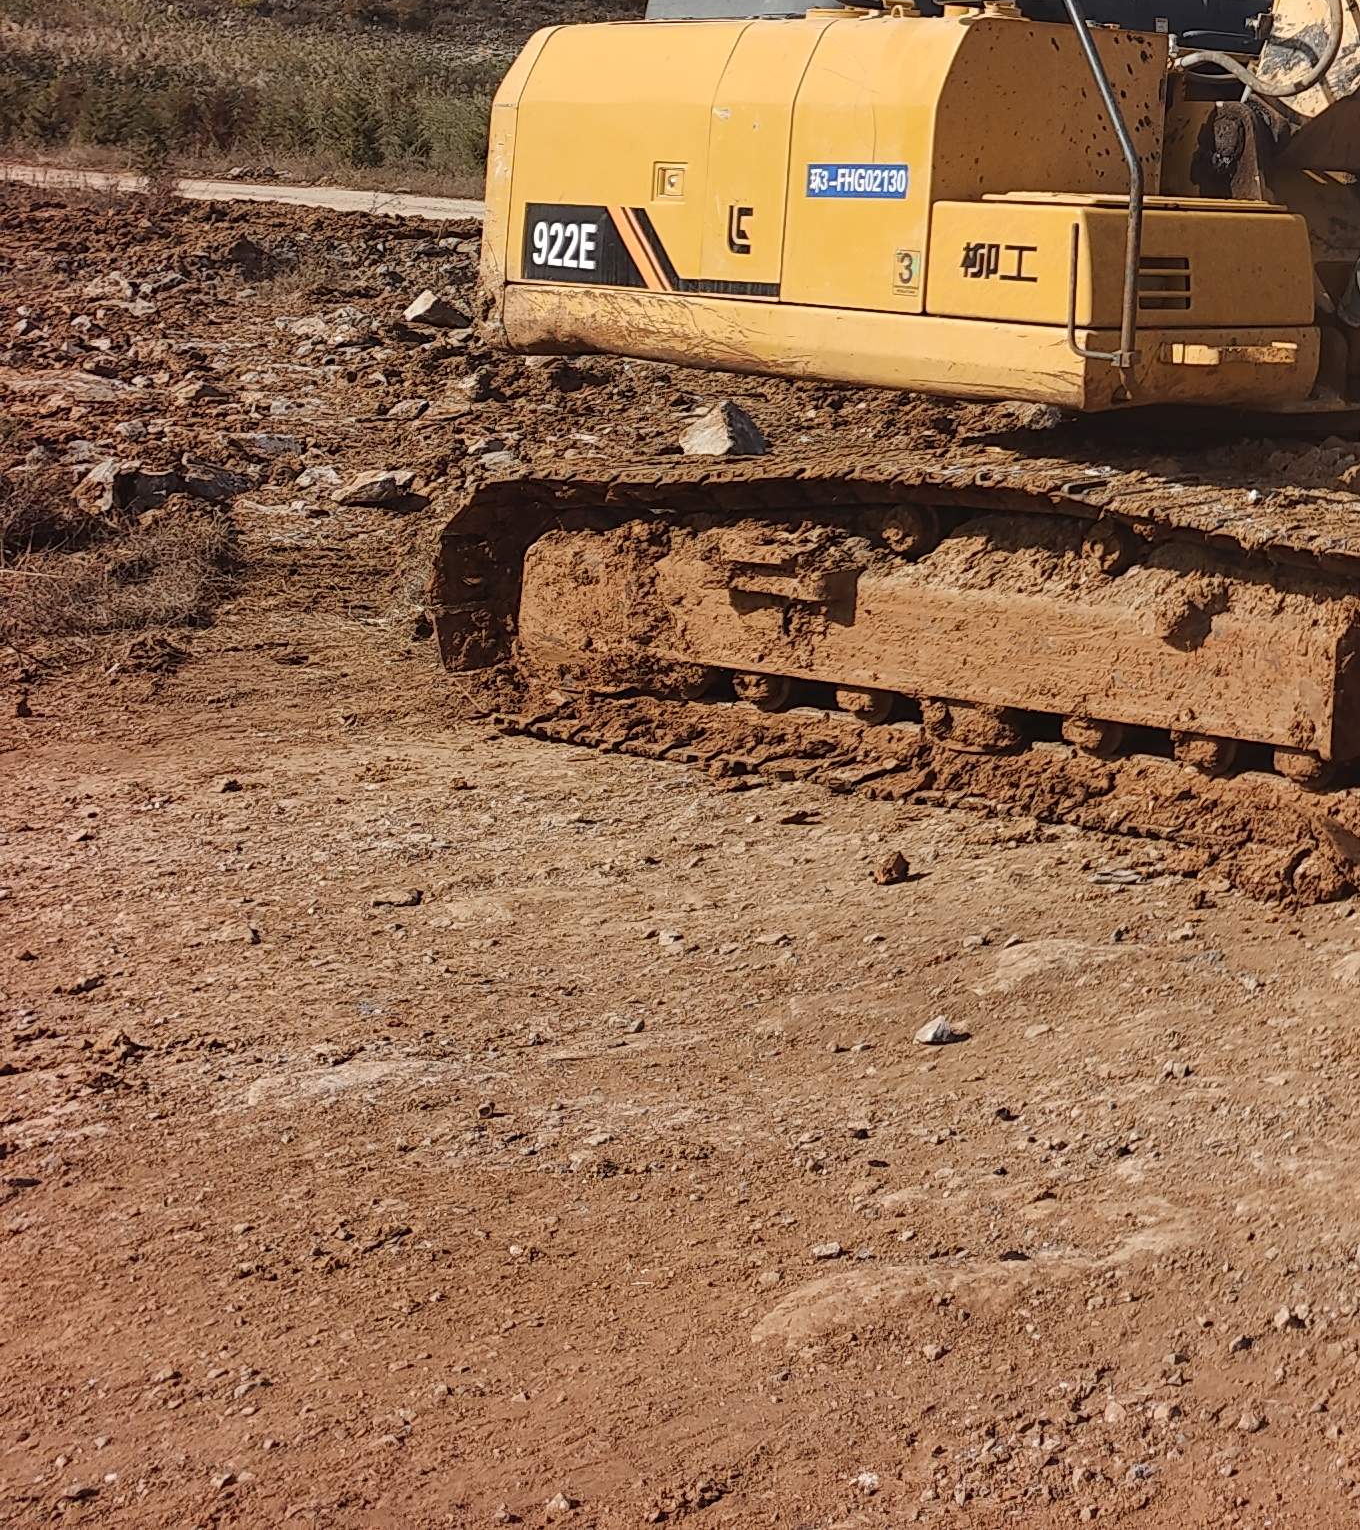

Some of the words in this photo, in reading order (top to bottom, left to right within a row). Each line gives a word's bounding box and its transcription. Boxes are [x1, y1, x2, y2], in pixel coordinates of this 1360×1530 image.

[532, 221, 597, 270] 922E
[959, 242, 1038, 283] 柳工
[897, 252, 913, 285] 3
